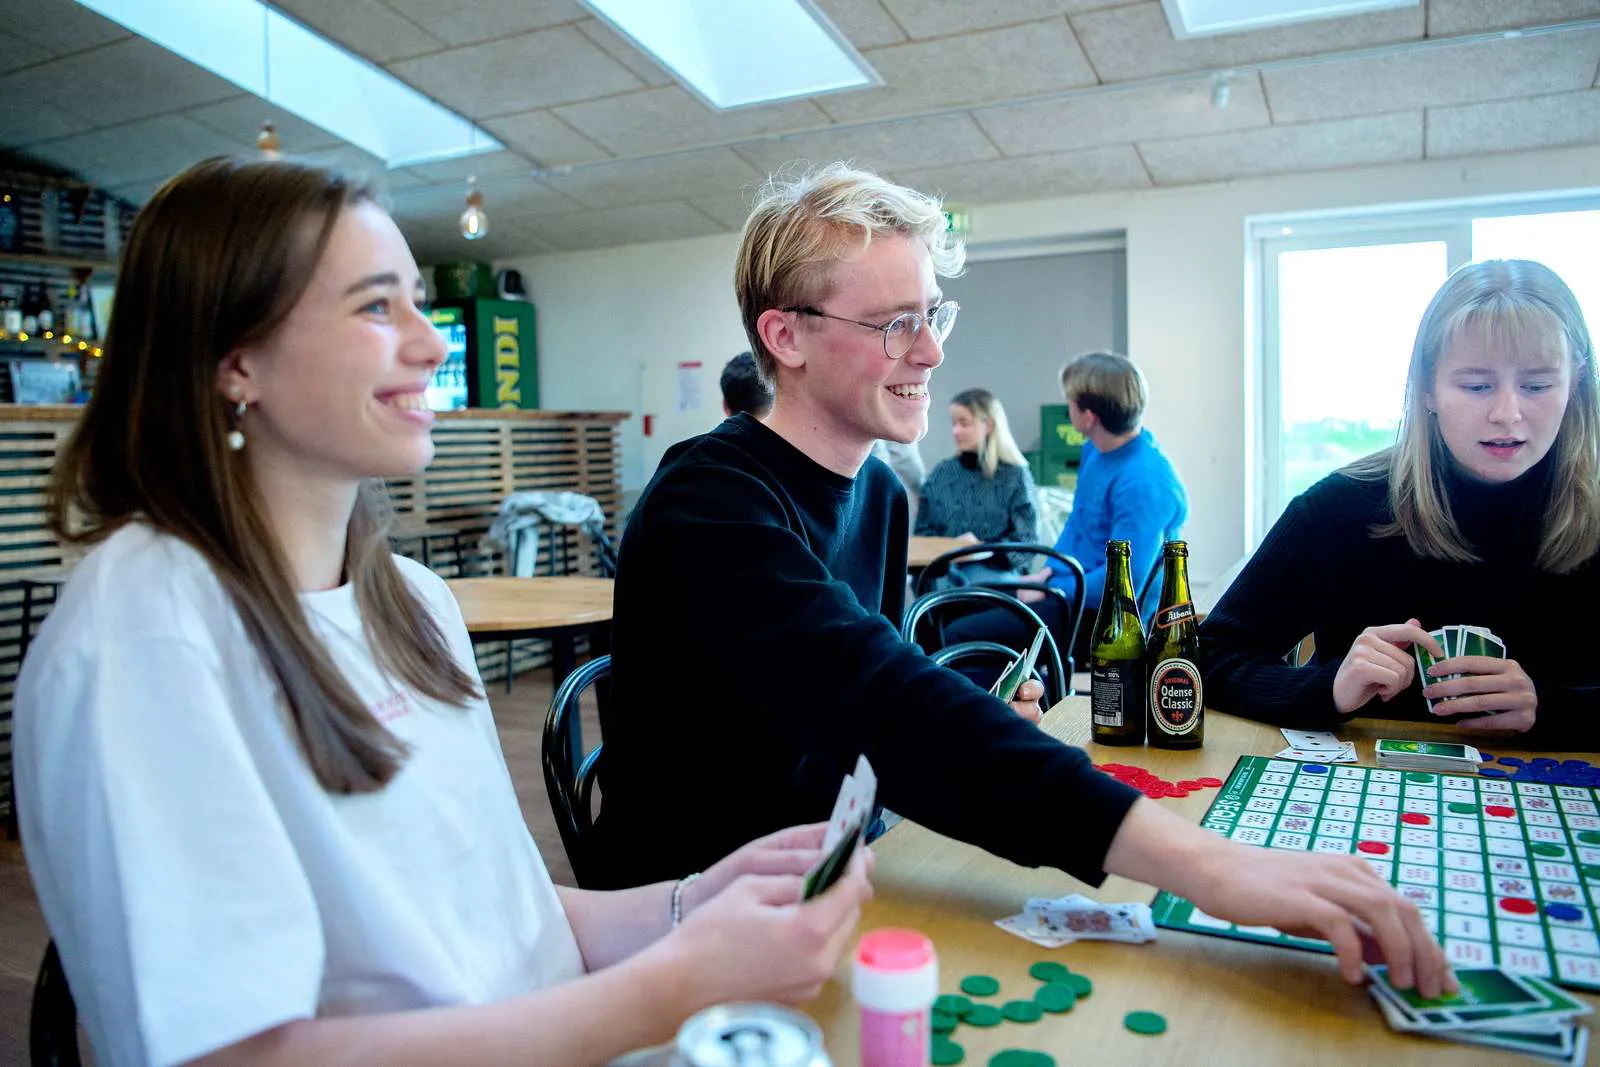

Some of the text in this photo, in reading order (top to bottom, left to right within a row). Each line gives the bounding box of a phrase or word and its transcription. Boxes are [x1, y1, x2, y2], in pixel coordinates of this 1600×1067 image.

[1167, 608, 1192, 622] Albani
[1161, 685, 1193, 697] Odense
[1161, 696, 1193, 709] Classic
[1204, 799, 1242, 836] SEQUE
